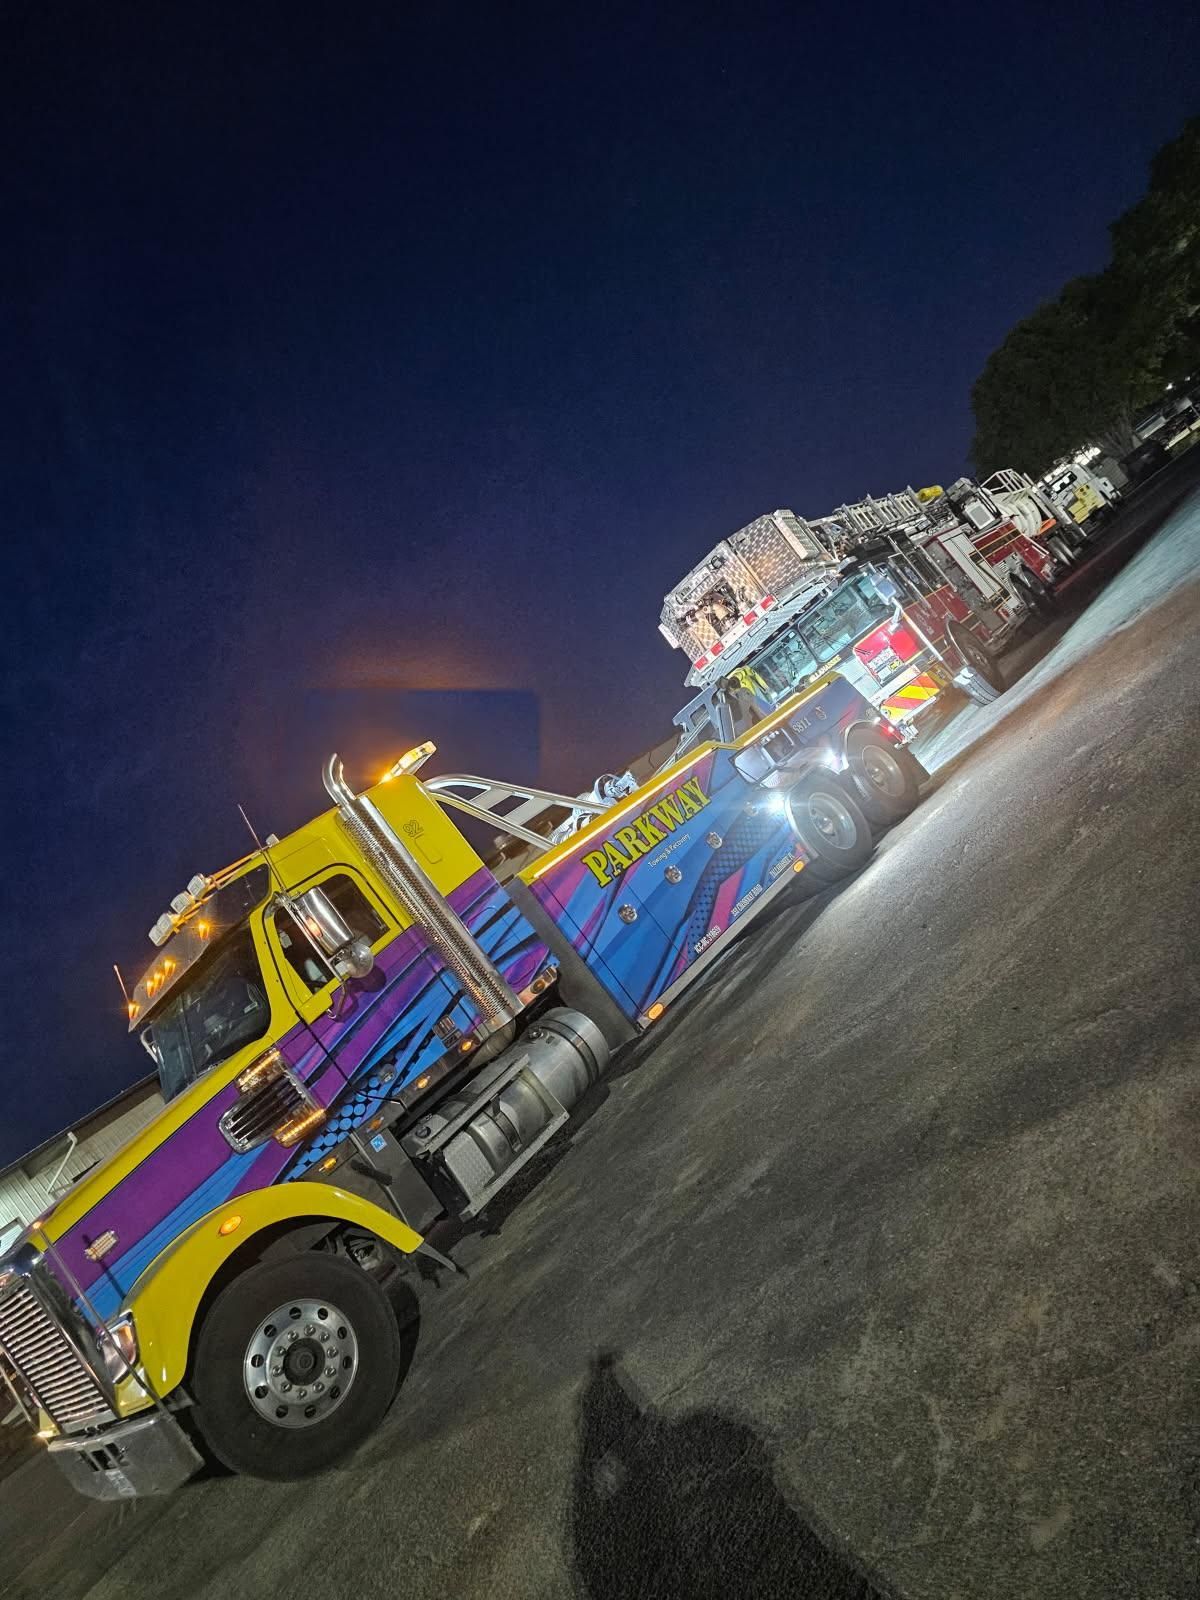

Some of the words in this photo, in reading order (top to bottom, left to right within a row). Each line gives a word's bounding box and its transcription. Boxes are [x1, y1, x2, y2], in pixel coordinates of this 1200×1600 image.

[581, 776, 712, 888] PARKWAY
[648, 852, 668, 867] Towing
[669, 833, 691, 850] Recovery
